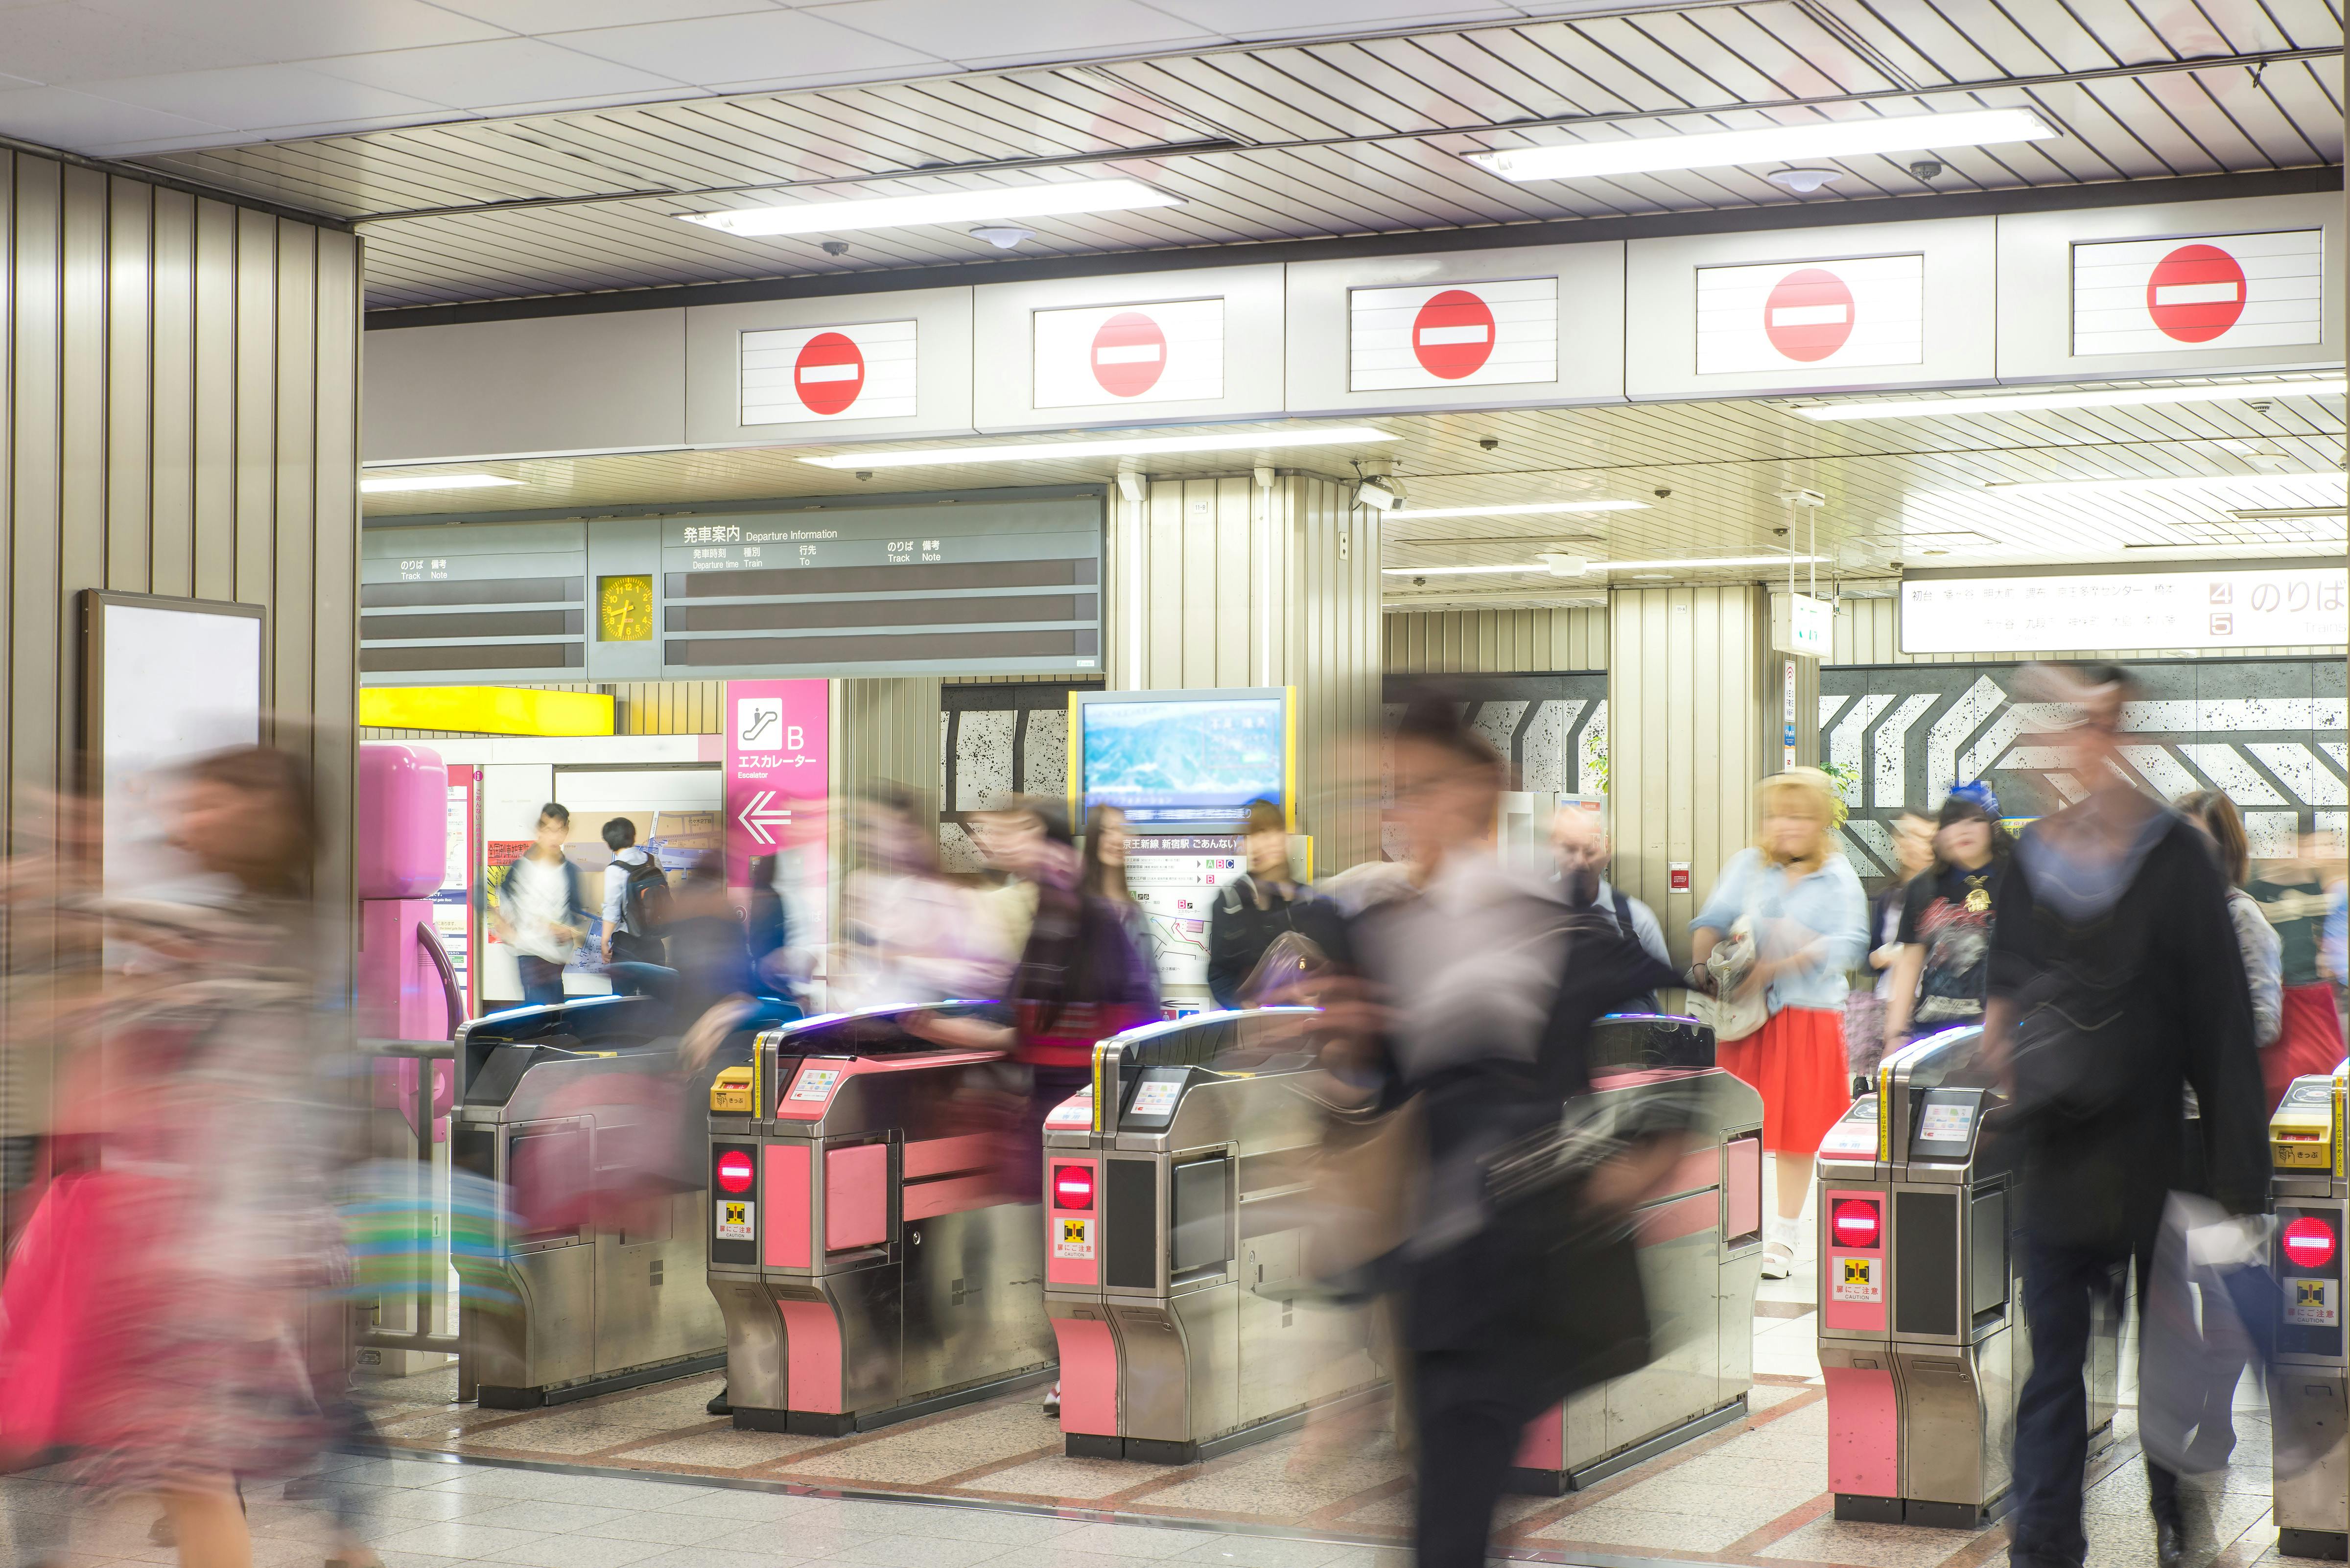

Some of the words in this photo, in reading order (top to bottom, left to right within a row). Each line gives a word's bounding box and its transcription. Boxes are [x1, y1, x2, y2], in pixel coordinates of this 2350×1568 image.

[684, 526, 739, 543] 発車案内
[746, 531, 788, 541] Departure
[790, 529, 837, 539] Information
[693, 548, 726, 559] 発車時刻
[744, 547, 760, 557] 種別
[799, 545, 817, 555] 行先
[888, 541, 913, 552] のりば
[922, 540, 940, 551] 備考
[400, 560, 423, 570] のりば
[431, 559, 446, 569] 備考
[693, 561, 724, 570] Departure
[744, 560, 762, 568] Train
[888, 554, 910, 562] Track
[922, 553, 940, 562] Note
[401, 571, 421, 580] Track
[431, 570, 448, 579] Note
[1912, 590, 1932, 601] 初台
[2211, 583, 2231, 604] 4
[2251, 580, 2346, 612] のりば
[2211, 613, 2231, 634] 5
[788, 726, 803, 750] B
[738, 754, 817, 768] エスカレーター
[1123, 839, 1159, 849] 京王新線
[1162, 839, 1190, 849] 新宿駅
[1193, 839, 1237, 849] ごあんない
[719, 1225, 752, 1234] 扉にご注意
[1057, 1243, 1092, 1252] 扉にご注意
[1836, 1286, 1878, 1295] 扉にご注意
[2288, 1308, 2334, 1318] 扉にご注意
